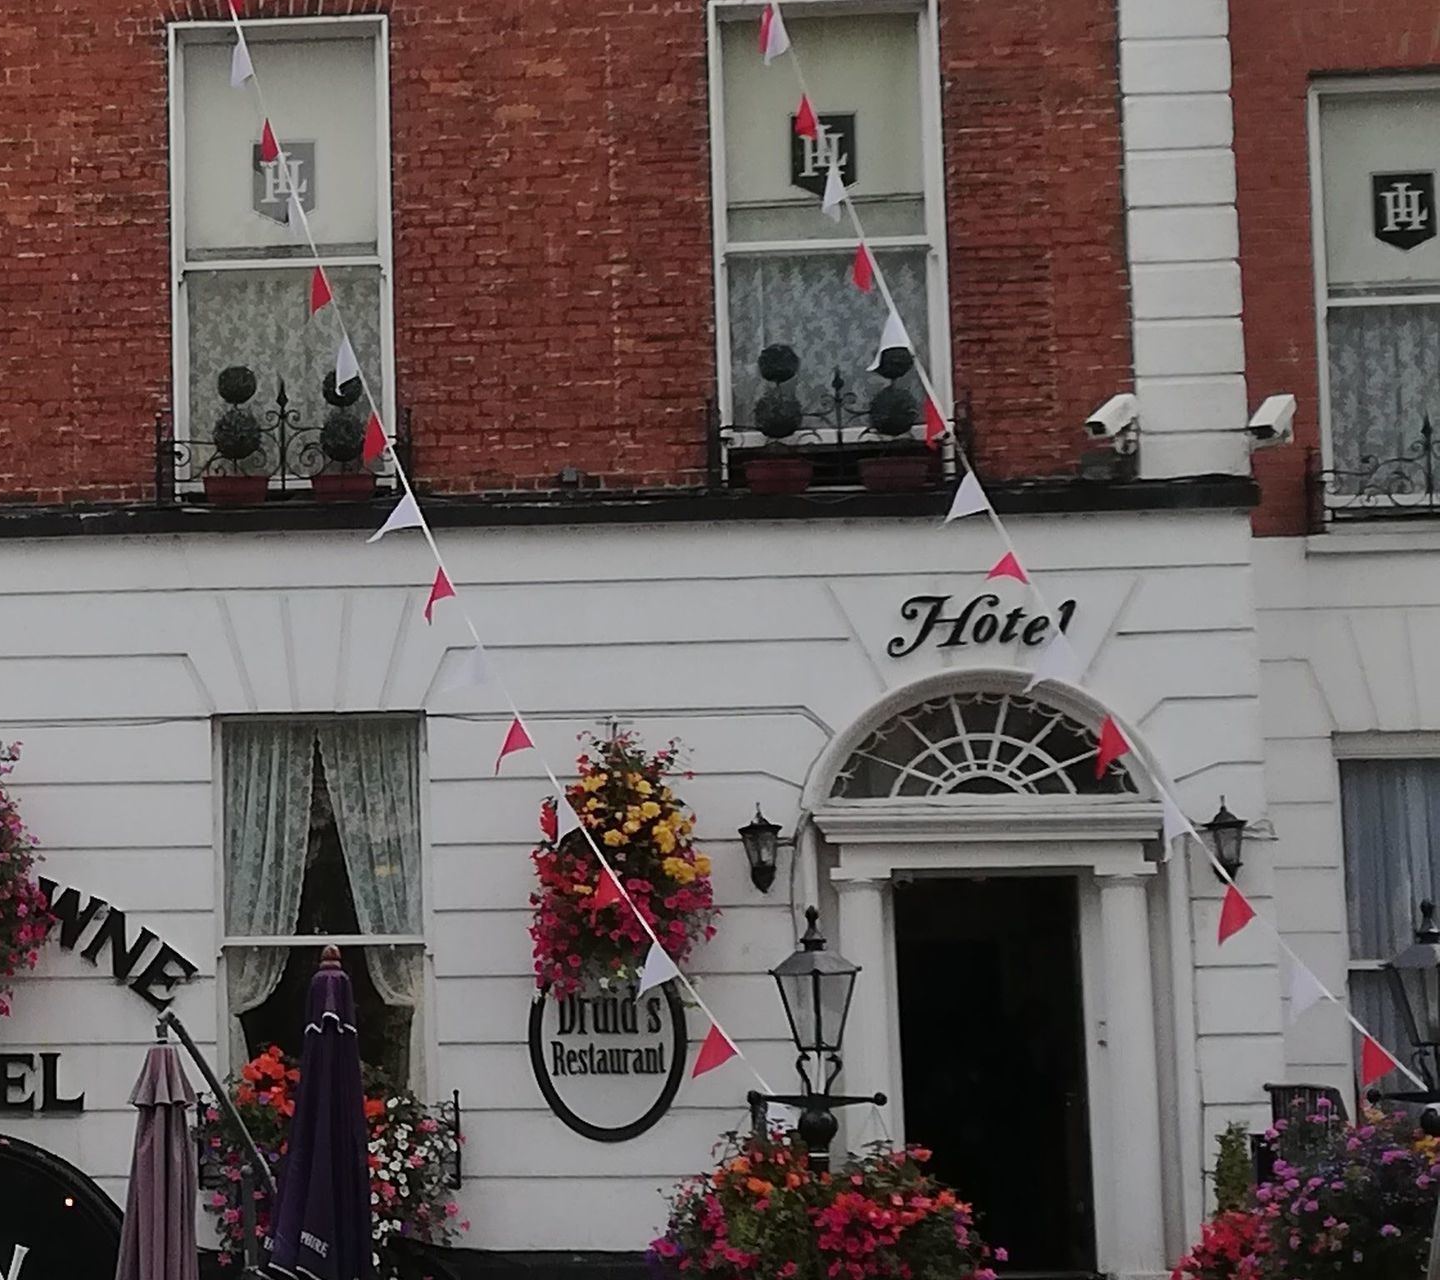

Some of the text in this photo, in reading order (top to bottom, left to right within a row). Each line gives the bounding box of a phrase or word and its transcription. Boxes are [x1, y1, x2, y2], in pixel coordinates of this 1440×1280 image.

[887, 593, 1077, 658] Hotel
[556, 984, 662, 1036] Druids
[550, 1040, 667, 1077] Restaurant
